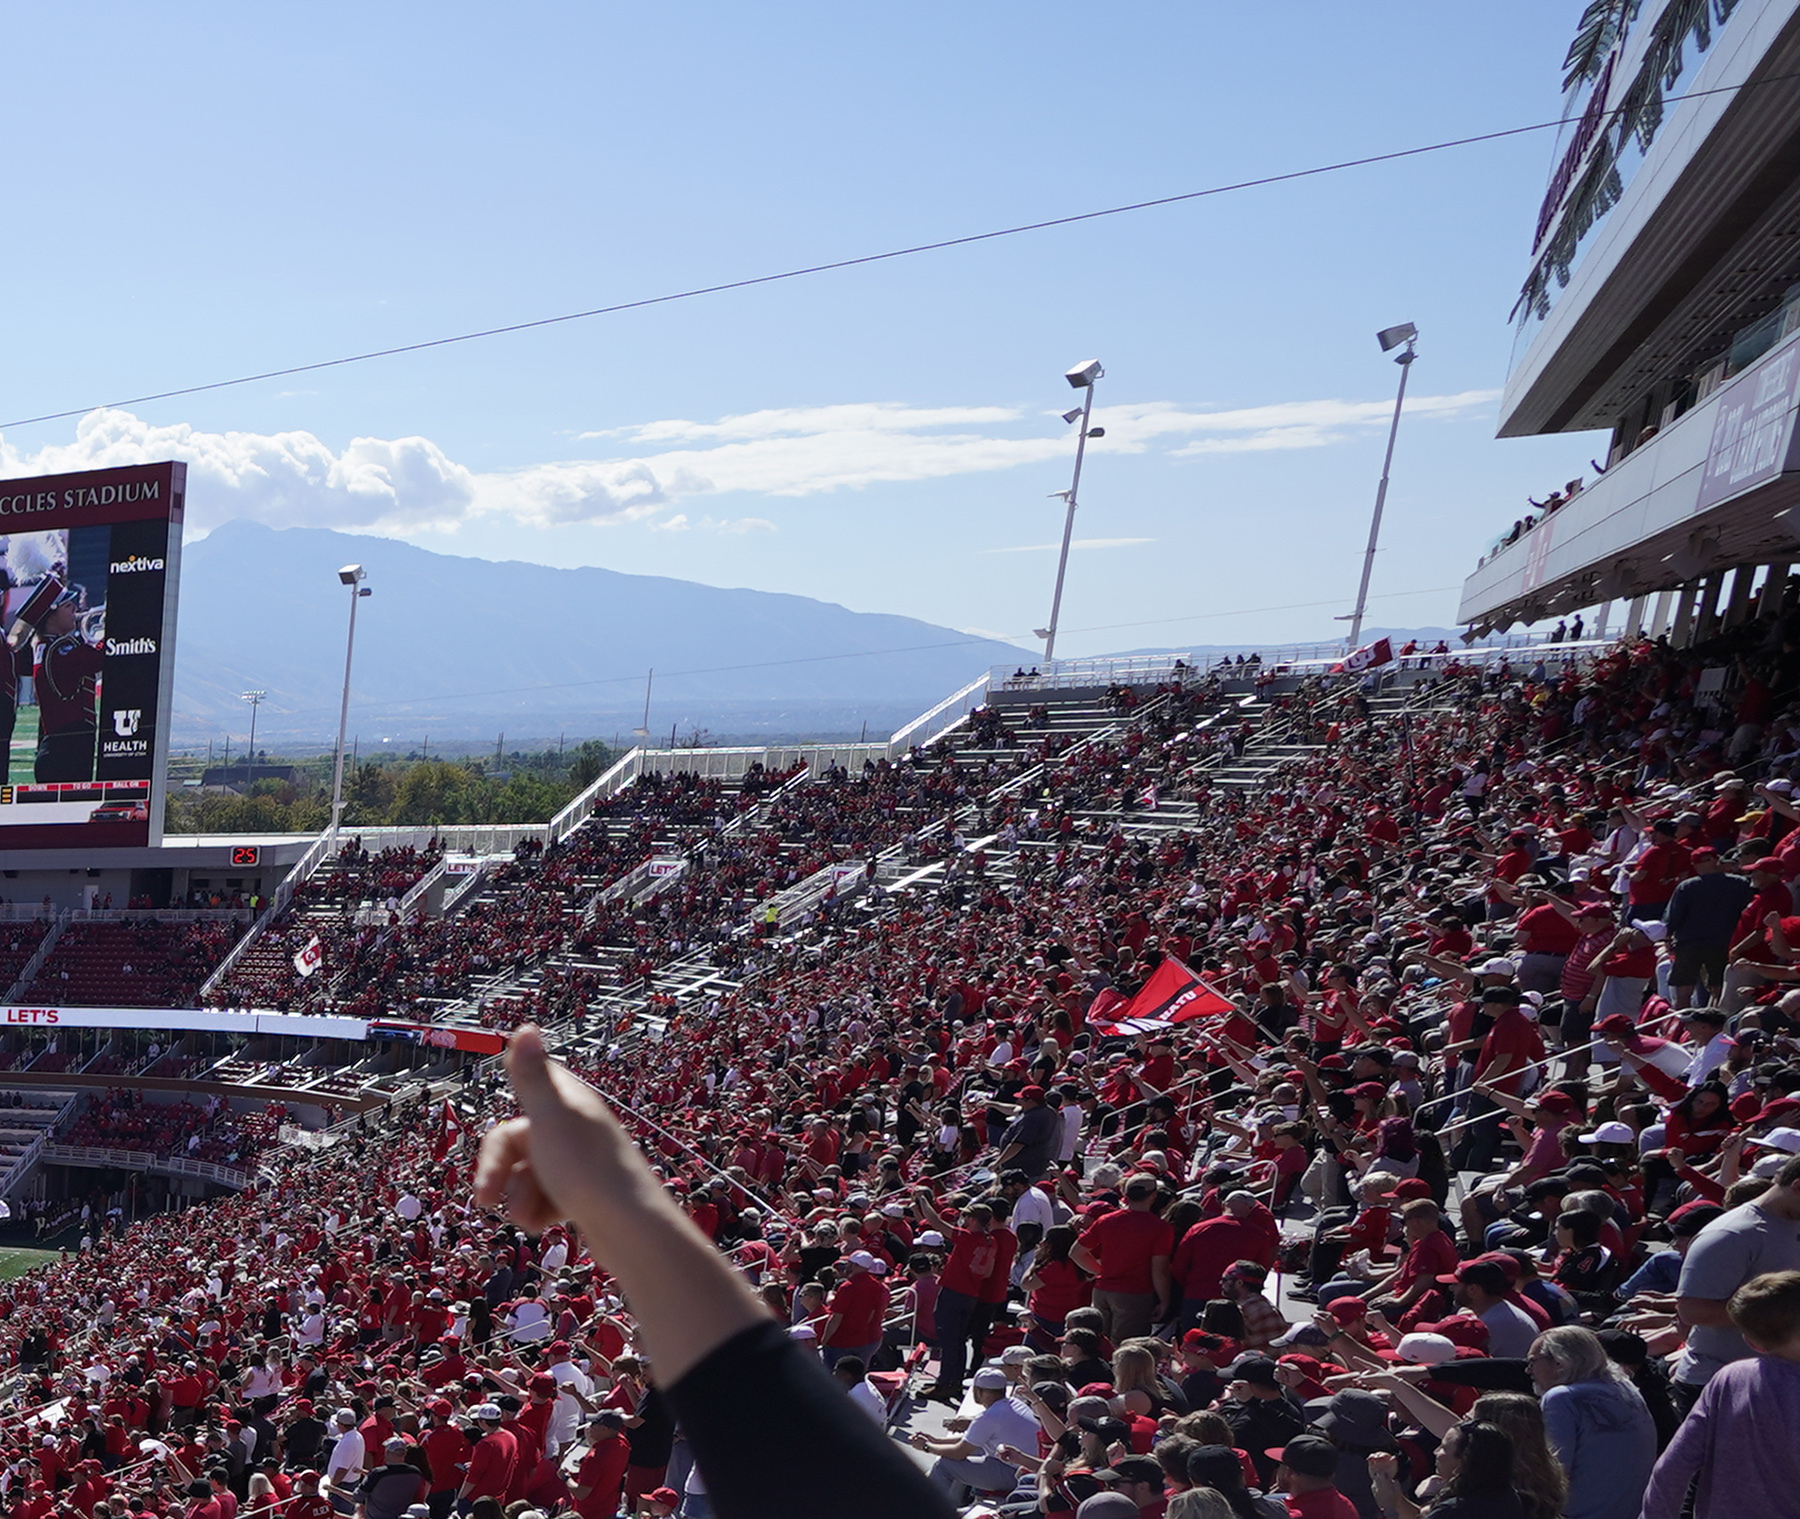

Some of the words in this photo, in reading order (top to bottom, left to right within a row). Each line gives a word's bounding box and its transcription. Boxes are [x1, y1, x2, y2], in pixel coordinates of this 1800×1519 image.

[64, 480, 160, 509] STADIUM
[110, 555, 164, 574] nextiva
[105, 637, 157, 656] Smith's
[103, 740, 147, 752] HEALTH
[234, 848, 255, 863] 25
[448, 864, 476, 872] LET'S
[8, 1009, 59, 1024] LET'S
[312, 1505, 330, 1517] OLSEN
